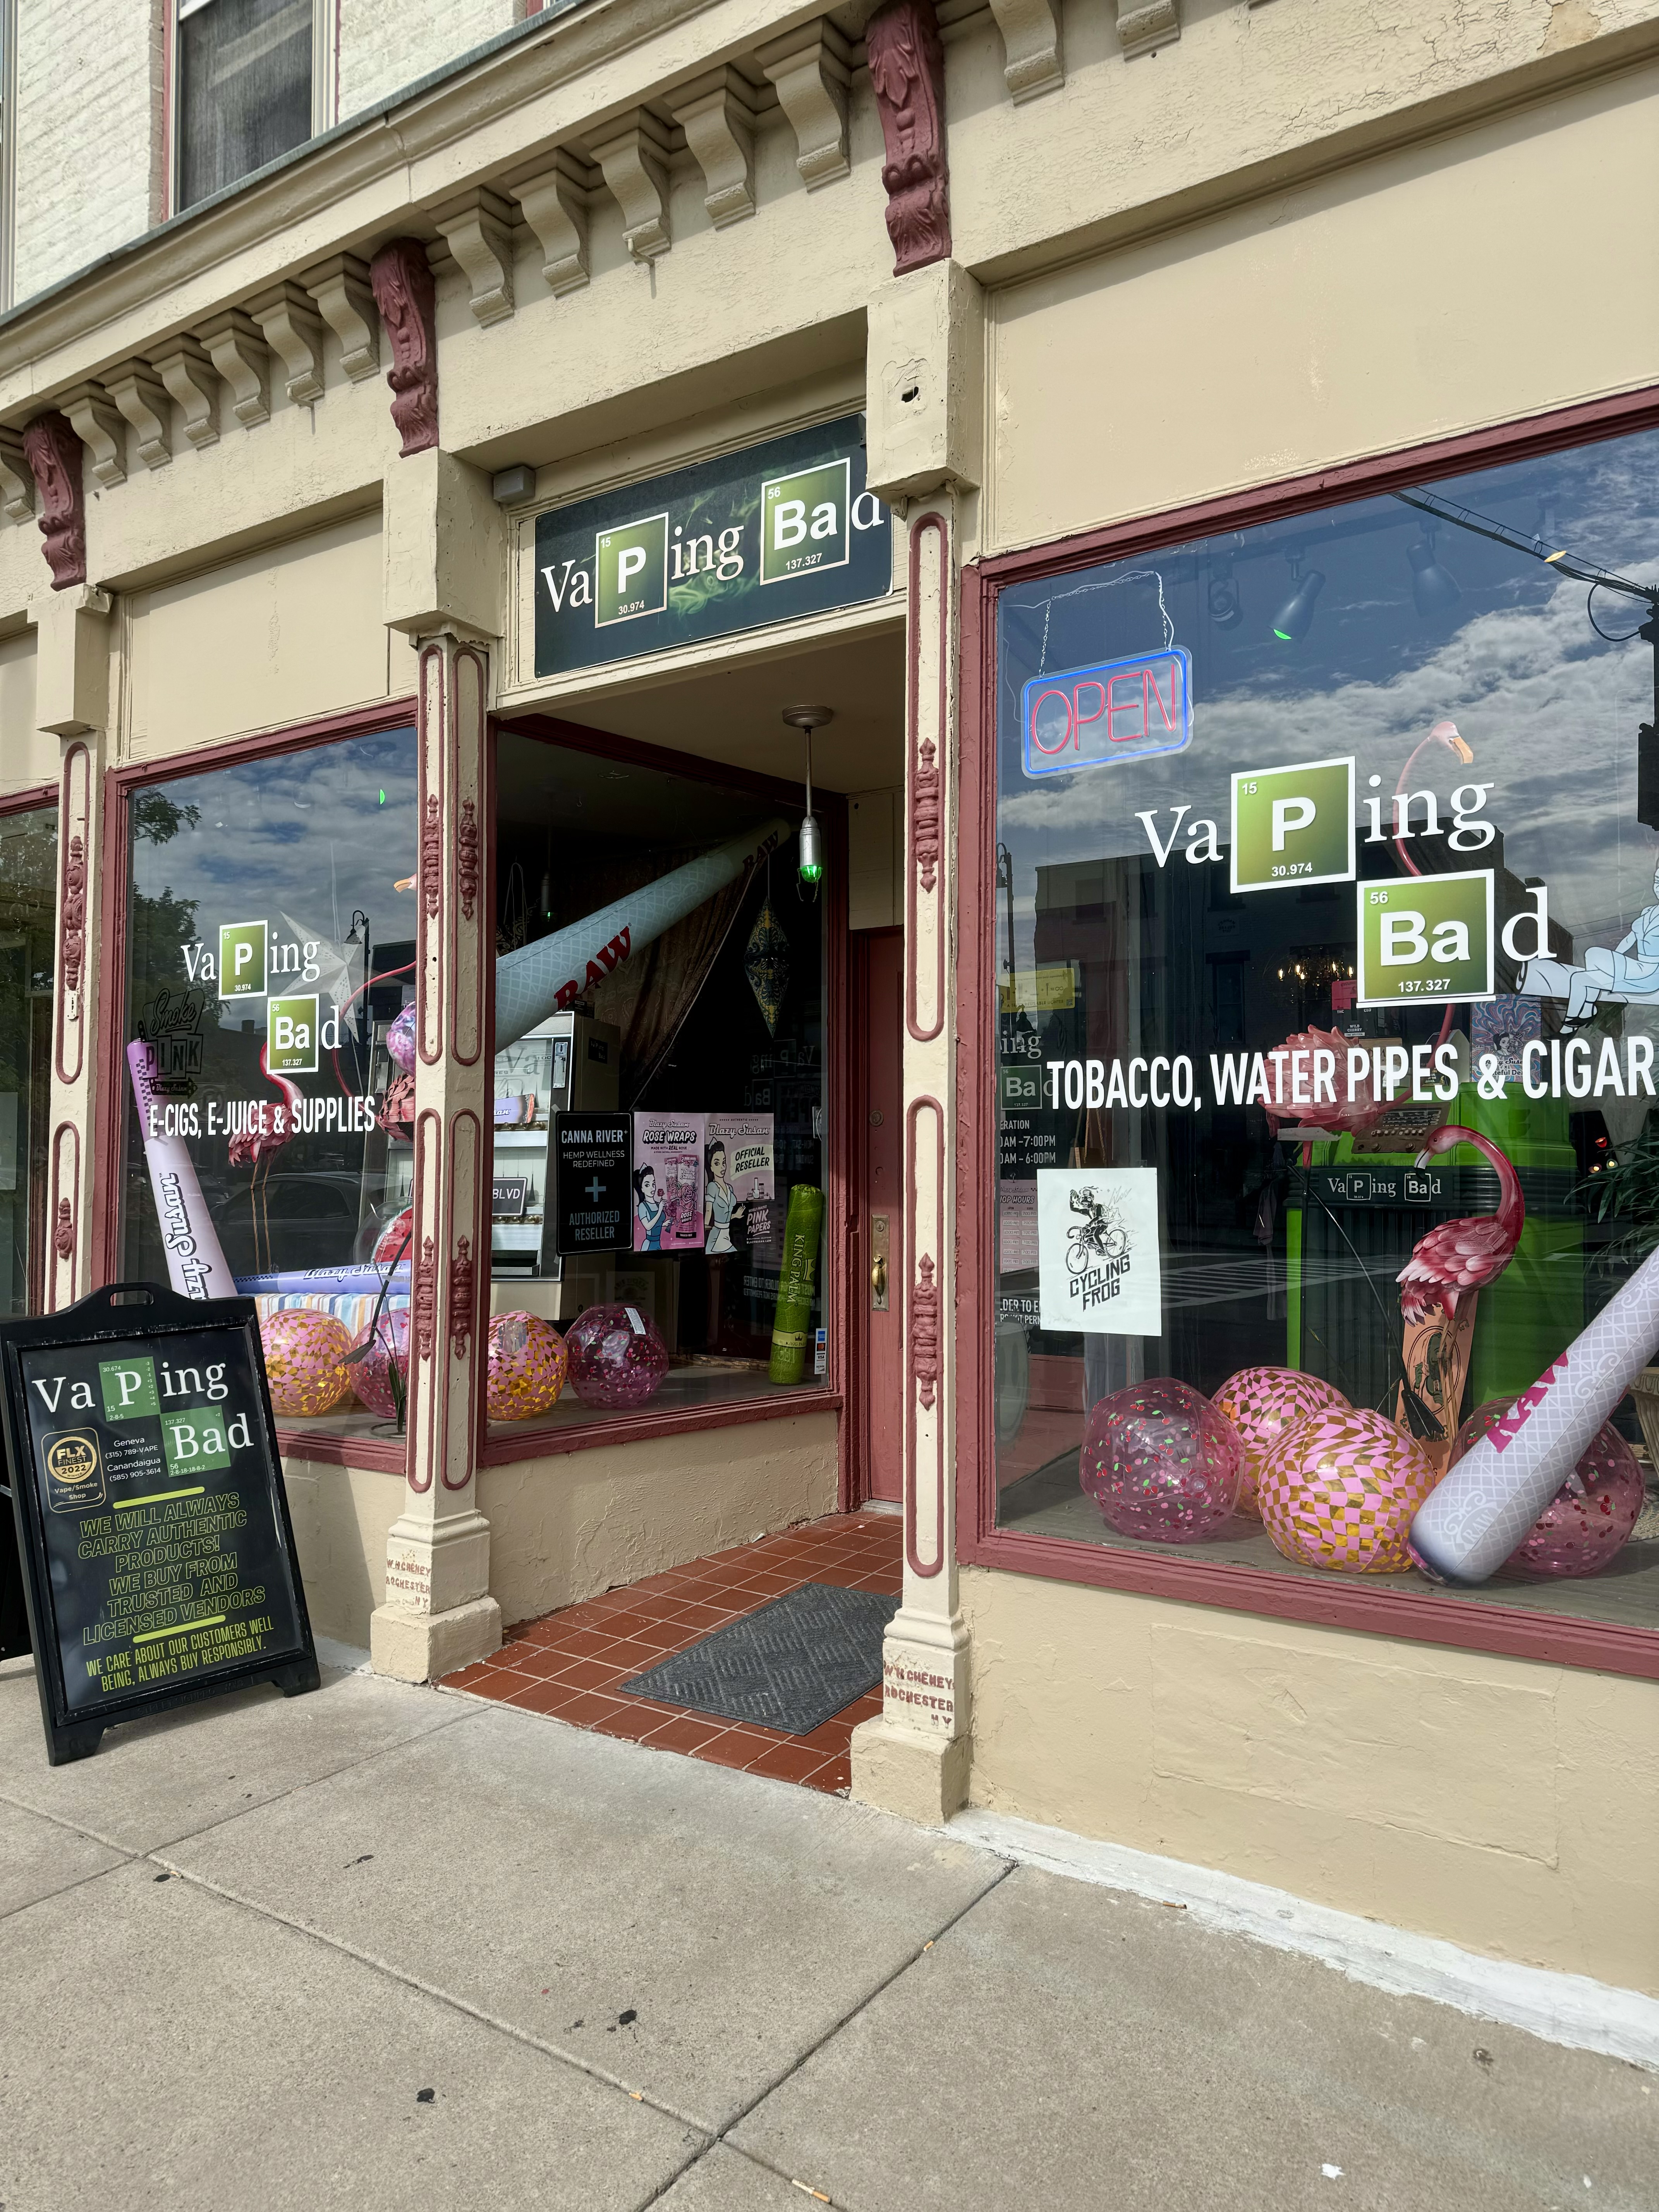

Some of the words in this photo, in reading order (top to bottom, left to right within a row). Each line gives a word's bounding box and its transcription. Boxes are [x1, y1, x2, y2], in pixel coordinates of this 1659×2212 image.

[767, 486, 781, 500] 56
[601, 537, 611, 548] 15
[785, 552, 823, 571] 137.327
[618, 600, 645, 615] 30.974
[1032, 664, 1176, 755] OPEN
[1241, 782, 1258, 795] 15
[742, 830, 778, 876] RAW
[1271, 862, 1313, 877] 30.974
[1369, 891, 1389, 905] 56
[223, 931, 230, 940] 15
[554, 926, 631, 1011] RAW
[234, 983, 252, 992] 30.974
[1398, 979, 1451, 993] 137.327
[150, 988, 197, 1036] Smoke
[271, 1003, 280, 1012] 56
[146, 1040, 200, 1071] PINK
[282, 1058, 303, 1066] 137.327
[1046, 1055, 1201, 1112] TOBACCO,
[1210, 1048, 1337, 1106] WATER
[1347, 1044, 1459, 1103] PIPES
[1477, 1054, 1508, 1100] &
[1522, 1036, 1657, 1099] CIGAR
[149, 1103, 202, 1140] E-CIGS,
[208, 1100, 268, 1136] E-JUICE
[273, 1106, 286, 1134] &
[291, 1096, 376, 1134] SUPPLIES
[649, 1119, 667, 1129] Blazy
[668, 1119, 689, 1128] Susan
[1000, 1120, 1030, 1129] ERATION
[562, 1130, 593, 1144] CANNA
[643, 1130, 665, 1144] ROSE
[666, 1130, 697, 1144] WRAPS
[709, 1123, 737, 1139] Blazy
[737, 1123, 770, 1135] Susan
[735, 1147, 765, 1161] OFFICIAL
[573, 1159, 615, 1168] REDEFINED
[735, 1157, 769, 1173] RESELLER
[493, 1188, 520, 1199] BLVD
[1012, 1195, 1035, 1204] HOURS
[160, 1173, 197, 1257] Susan
[569, 1210, 620, 1225] AUTHORIZED
[680, 1210, 693, 1219] ROSE
[747, 1209, 769, 1225] PINK
[575, 1226, 615, 1241] RESELLER
[747, 1221, 771, 1235] PAPERS
[791, 1233, 805, 1267] KING
[303, 1268, 349, 1283] Blazy
[1070, 1254, 1130, 1298] CYCLING
[787, 1270, 801, 1304] PALM
[1083, 1278, 1120, 1312] FROG
[1021, 1300, 1031, 1312] TO
[114, 1437, 145, 1447] Geneva
[169, 1413, 254, 1460] Bad
[57, 1445, 86, 1460] FLX
[105, 1451, 122, 1459] (315)
[124, 1445, 159, 1456] 789-VAPE
[58, 1455, 87, 1466] FINEST
[107, 1458, 161, 1472] Canandaigua
[61, 1464, 86, 1474] 2022
[110, 1474, 128, 1482] (585)
[130, 1467, 161, 1478] 905-3614
[170, 1465, 206, 1476] 2-8-18-18-8-2
[55, 1482, 98, 1494] Vape/Smoke
[80, 1516, 112, 1538] WE
[115, 1508, 161, 1531] WILL
[164, 1492, 240, 1522] ALWAYS
[78, 1530, 143, 1559] CARRY
[147, 1510, 247, 1546] AUTHENTIC
[116, 1535, 220, 1573] PRODUCTS!
[109, 1573, 141, 1596] WE
[144, 1563, 182, 1589] BUY
[186, 1552, 237, 1579] FROM
[386, 1558, 394, 1568] W
[395, 1560, 400, 1569] H
[401, 1561, 431, 1577] CHENEY
[386, 1576, 431, 1594] ROCHESTER
[107, 1583, 193, 1618] TRUSTED
[201, 1573, 238, 1596] AND
[415, 1596, 420, 1606] N
[422, 1598, 428, 1608] Y
[83, 1607, 177, 1645] LICENSED
[180, 1586, 265, 1621] VENDORS
[86, 1658, 103, 1677] WE
[106, 1651, 132, 1671] CARE
[136, 1643, 165, 1665] ABOUT
[168, 1637, 188, 1656] OUR
[191, 1622, 247, 1649] CUSTOMERS
[249, 1616, 274, 1635] WELL
[101, 1670, 135, 1692] BEING,
[138, 1657, 177, 1682] ALWAYS
[181, 1652, 198, 1671] BUY
[202, 1635, 266, 1665] RESPONSIBLY.
[884, 1665, 893, 1676] W
[885, 1685, 953, 1712] ROCHESTER
[942, 1716, 952, 1728] Y
